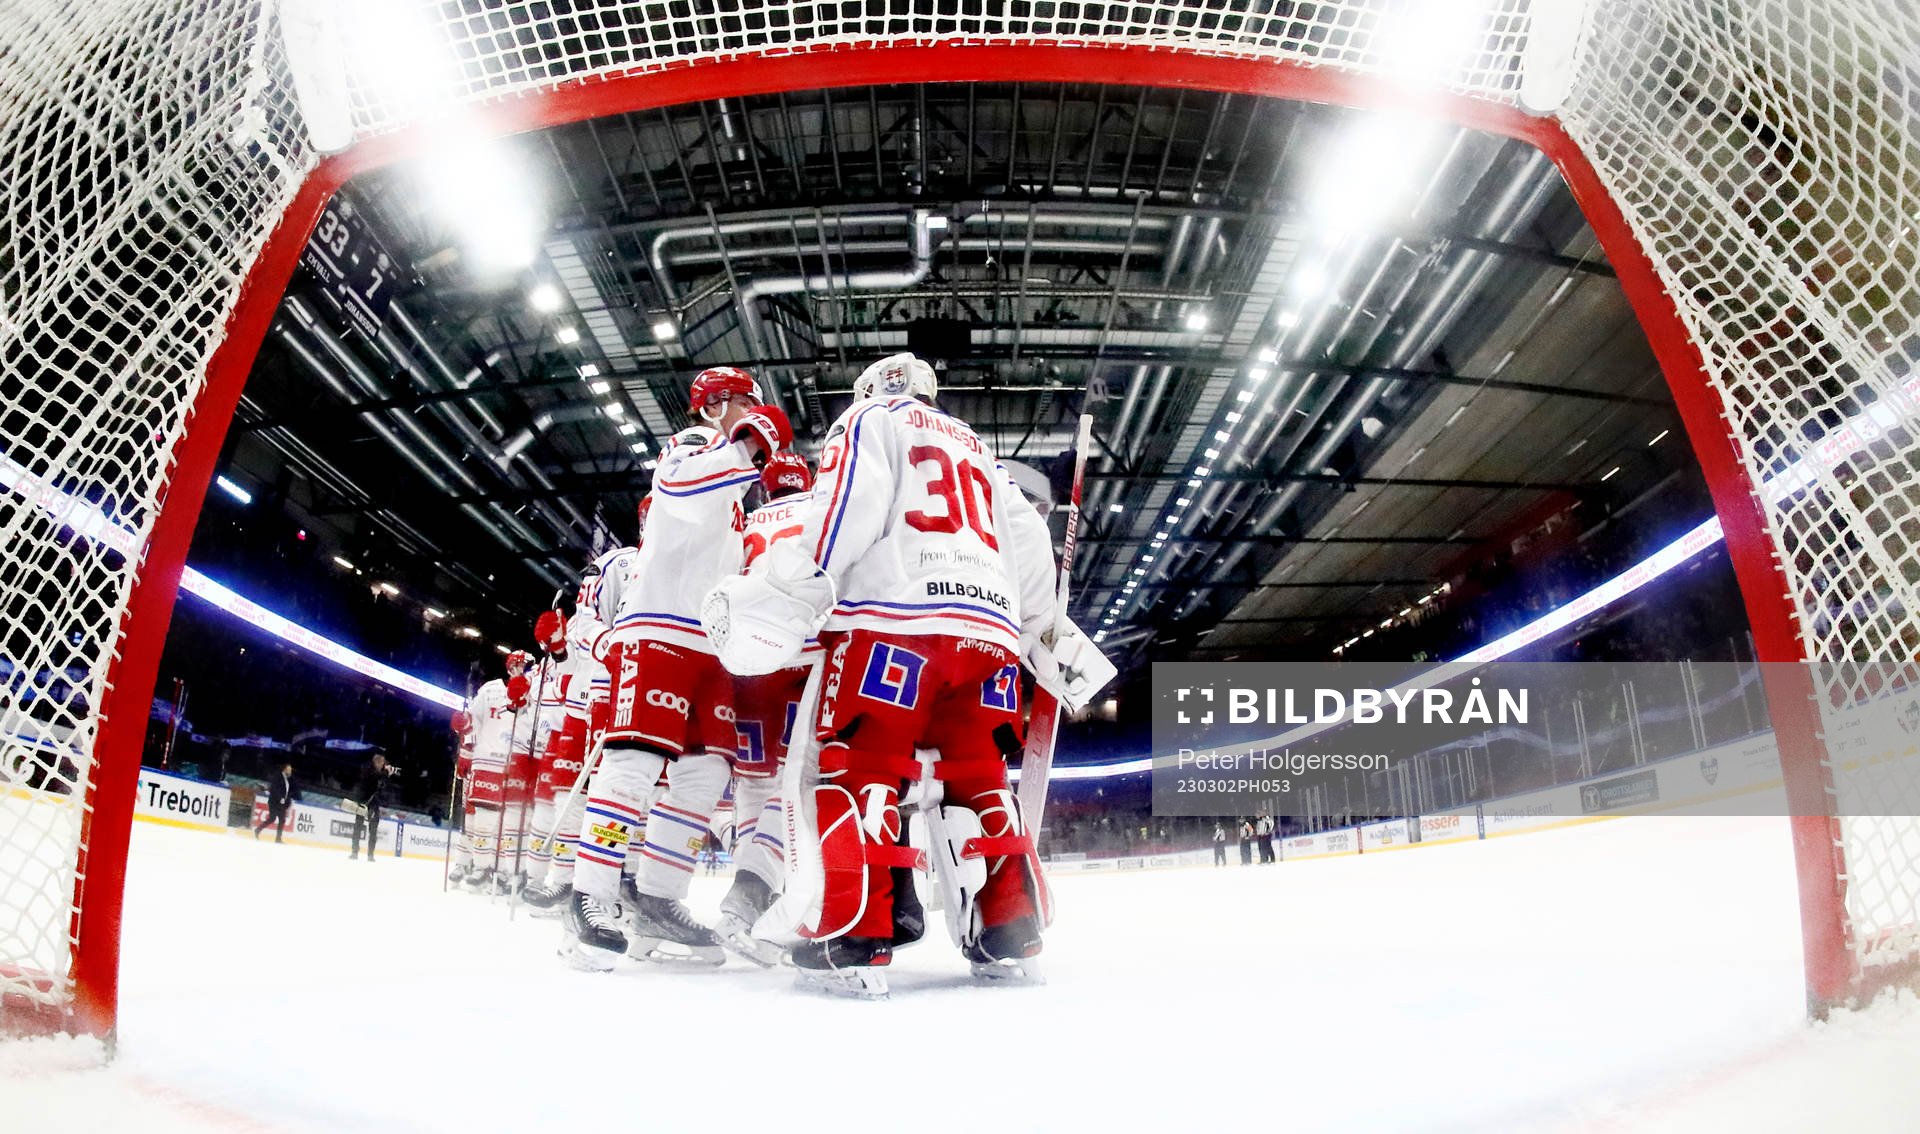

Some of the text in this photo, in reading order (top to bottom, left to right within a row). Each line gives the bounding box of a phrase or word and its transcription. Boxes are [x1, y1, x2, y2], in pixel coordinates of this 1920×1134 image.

[318, 210, 350, 257] 33
[366, 268, 383, 300] 7
[343, 300, 377, 337] JOHANSSON
[905, 445, 999, 553] 30
[147, 782, 221, 819] Trebolit
[297, 813, 313, 824] ALL
[1527, 803, 1553, 818] Event
